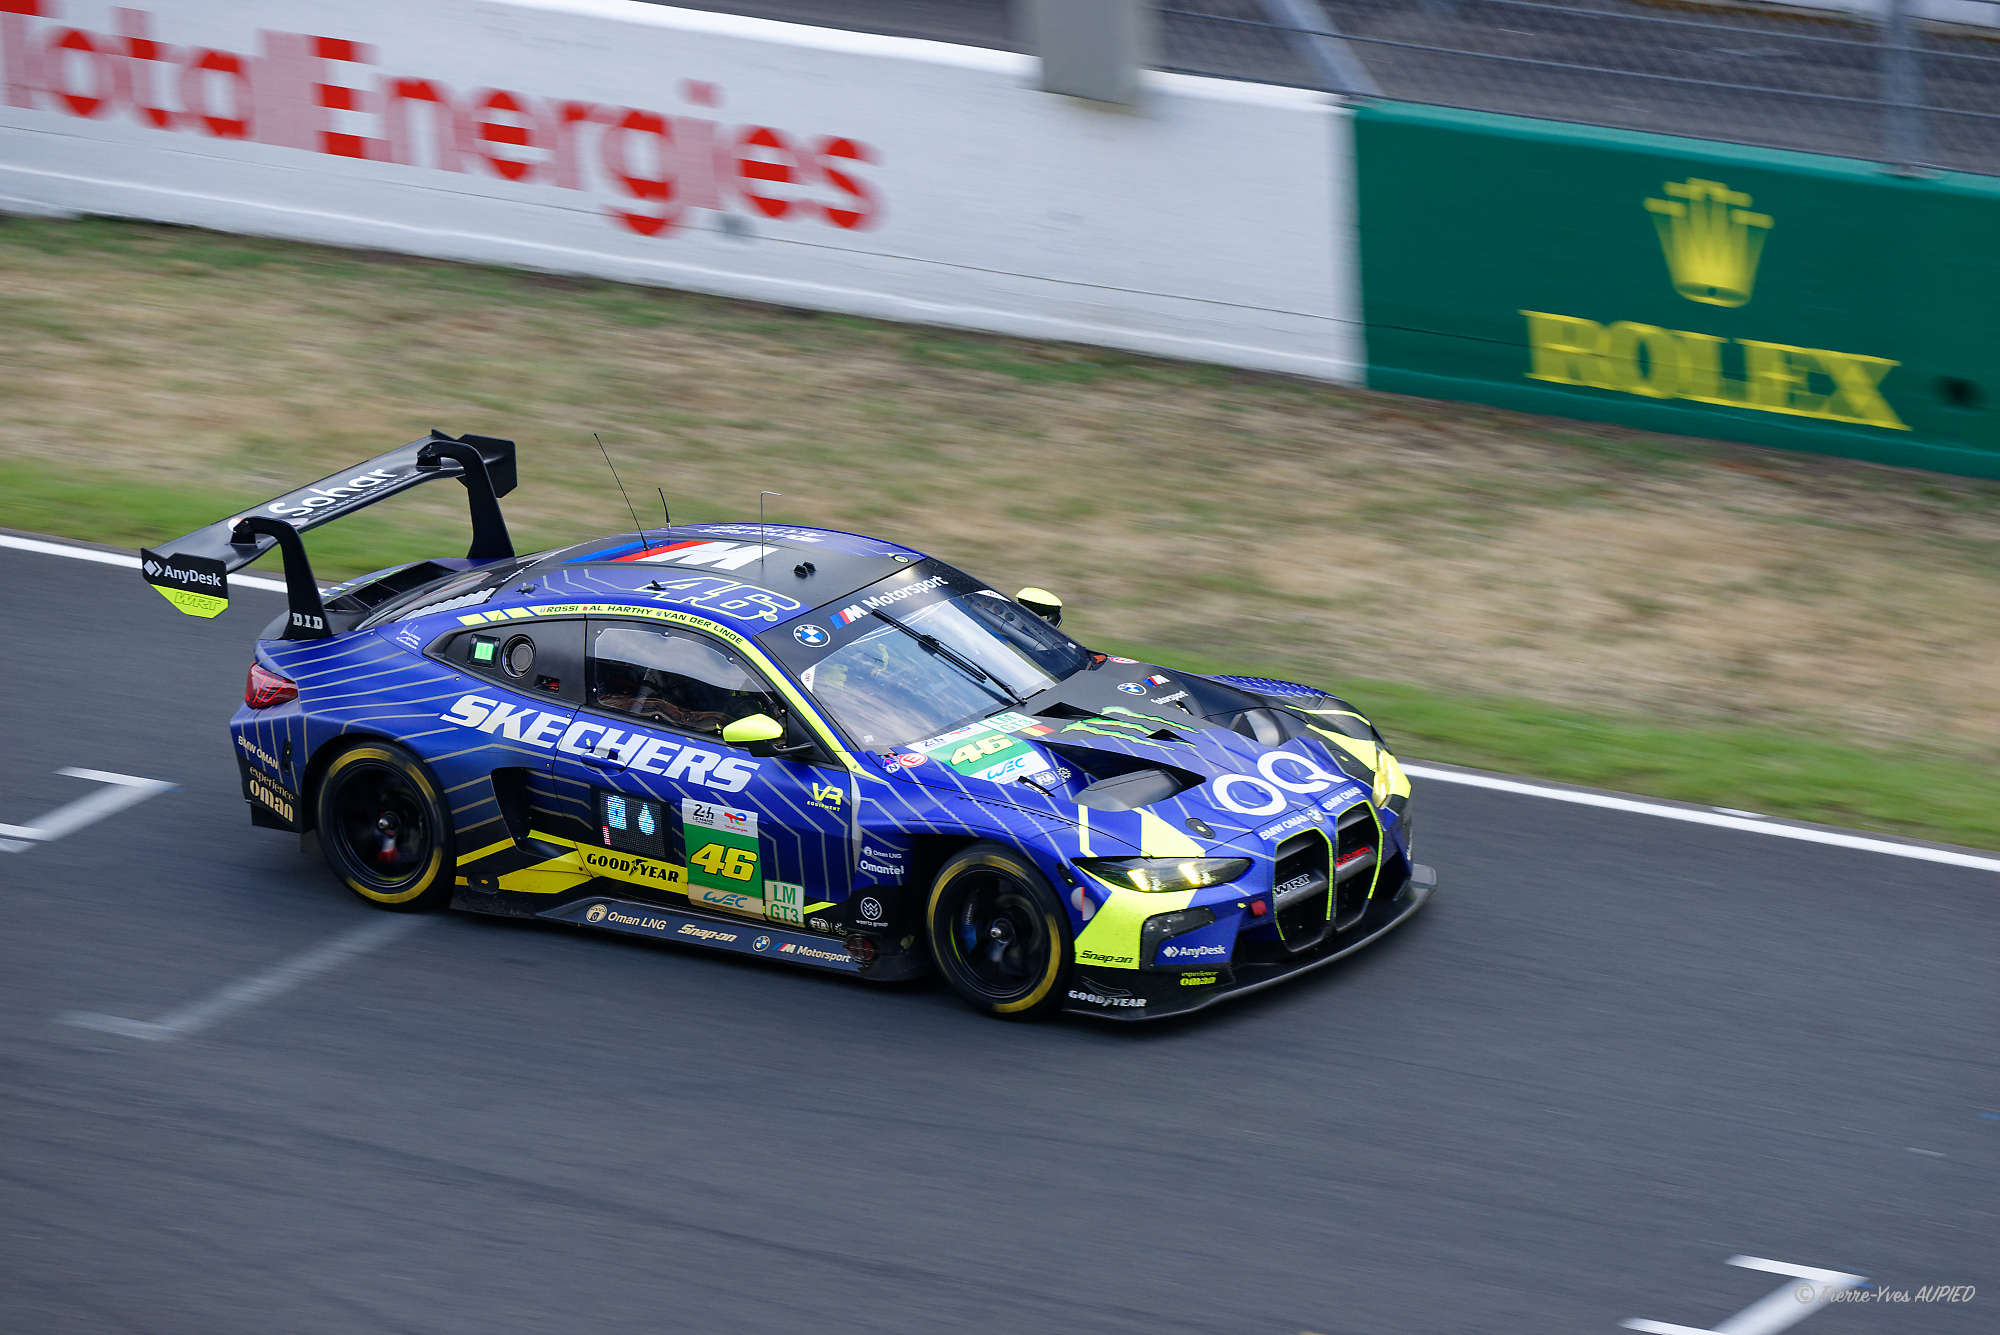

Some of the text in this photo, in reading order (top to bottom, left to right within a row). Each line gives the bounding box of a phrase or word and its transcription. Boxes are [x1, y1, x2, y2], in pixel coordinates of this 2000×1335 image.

[1519, 310, 1912, 431] ROLEX
[268, 469, 398, 517] Sohar
[164, 565, 221, 586] AnyDesk
[175, 591, 222, 611] WRT
[861, 575, 949, 609] Motorsport
[546, 604, 744, 645] ROSSI AL HARTHY VAN DER LINDE
[238, 735, 279, 770] BMW OMAN
[439, 694, 761, 793] SKECHERS
[950, 733, 1015, 766] 46
[986, 757, 1025, 780] WEC
[249, 766, 295, 800] experience
[249, 779, 294, 823] oman
[586, 853, 680, 884] GOODYEAR
[690, 842, 758, 882] 46
[859, 860, 905, 875] Omantel
[773, 884, 796, 906] LM
[1273, 873, 1310, 898] WRT
[703, 890, 748, 909] WEC
[607, 911, 667, 930] Oman LNG
[770, 903, 799, 925] GT3
[677, 923, 738, 943] Snap-on
[796, 945, 852, 963] Motorsport
[1079, 949, 1134, 965] Snap-on
[1178, 944, 1227, 959] AnyDesk
[1068, 989, 1148, 1008] GOODYEAR
